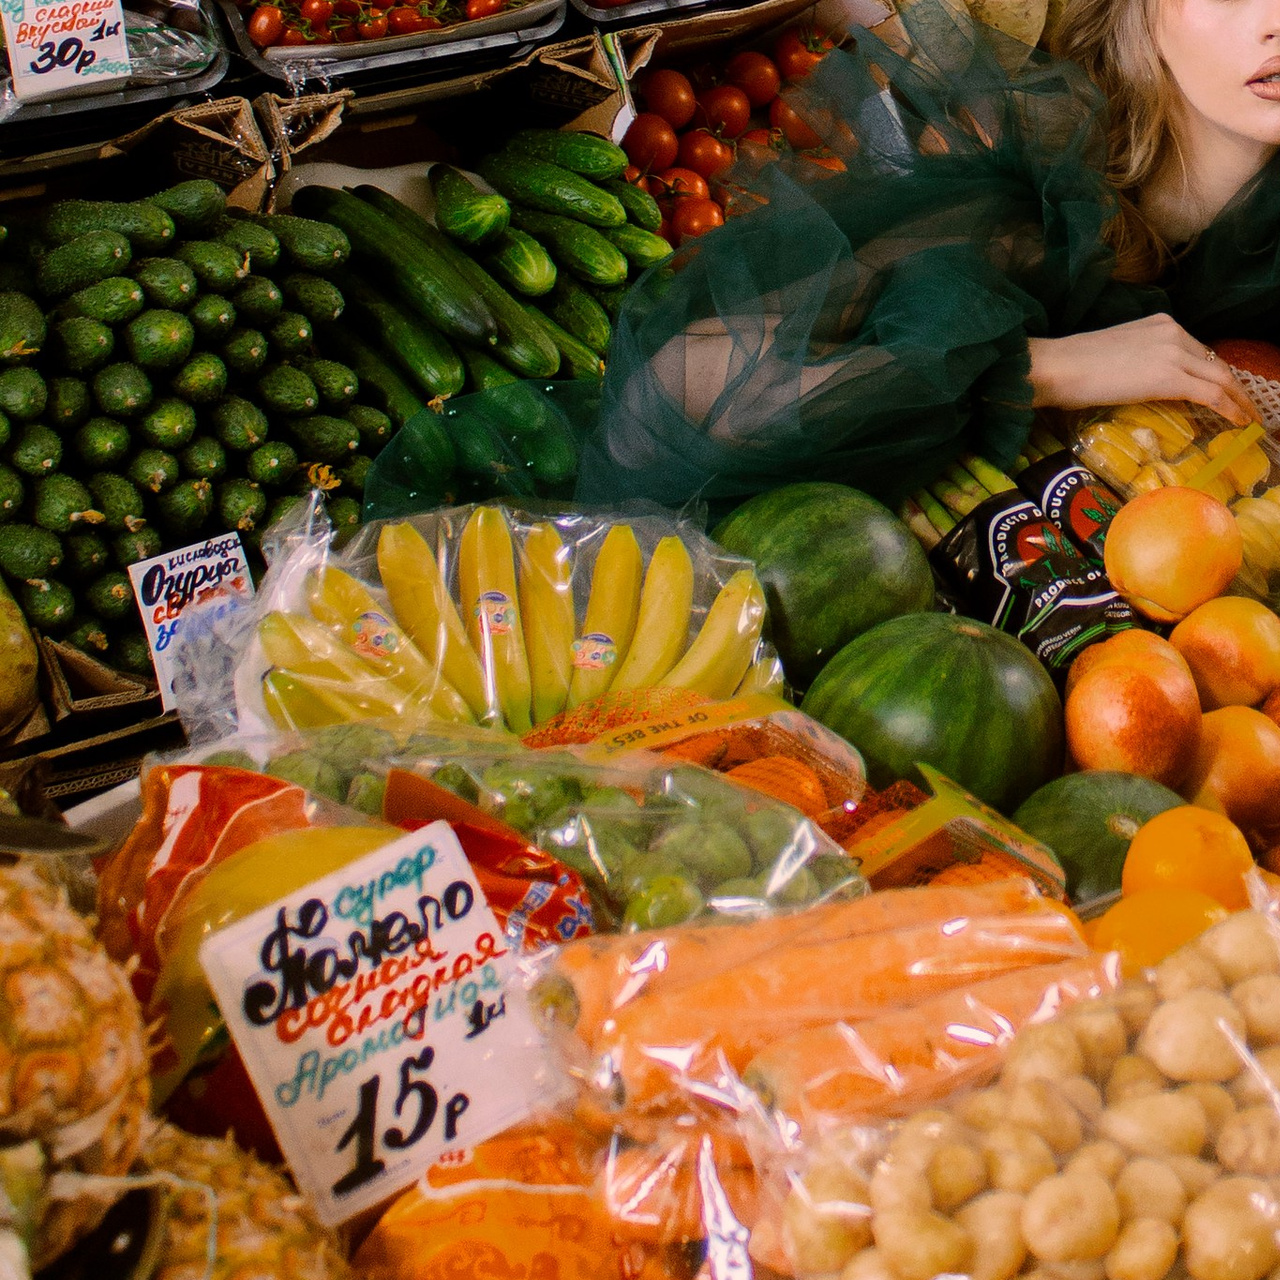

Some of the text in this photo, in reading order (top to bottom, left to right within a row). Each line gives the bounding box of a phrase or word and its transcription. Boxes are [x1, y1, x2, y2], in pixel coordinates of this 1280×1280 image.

[30, 37, 97, 75] 30р
[604, 728, 647, 754] BEST
[648, 720, 683, 735] THE
[333, 845, 436, 926] супер
[244, 880, 474, 1025] Помело
[276, 938, 448, 1044] сочная
[326, 932, 508, 1047] сладкая
[332, 1046, 470, 1199] 15р
